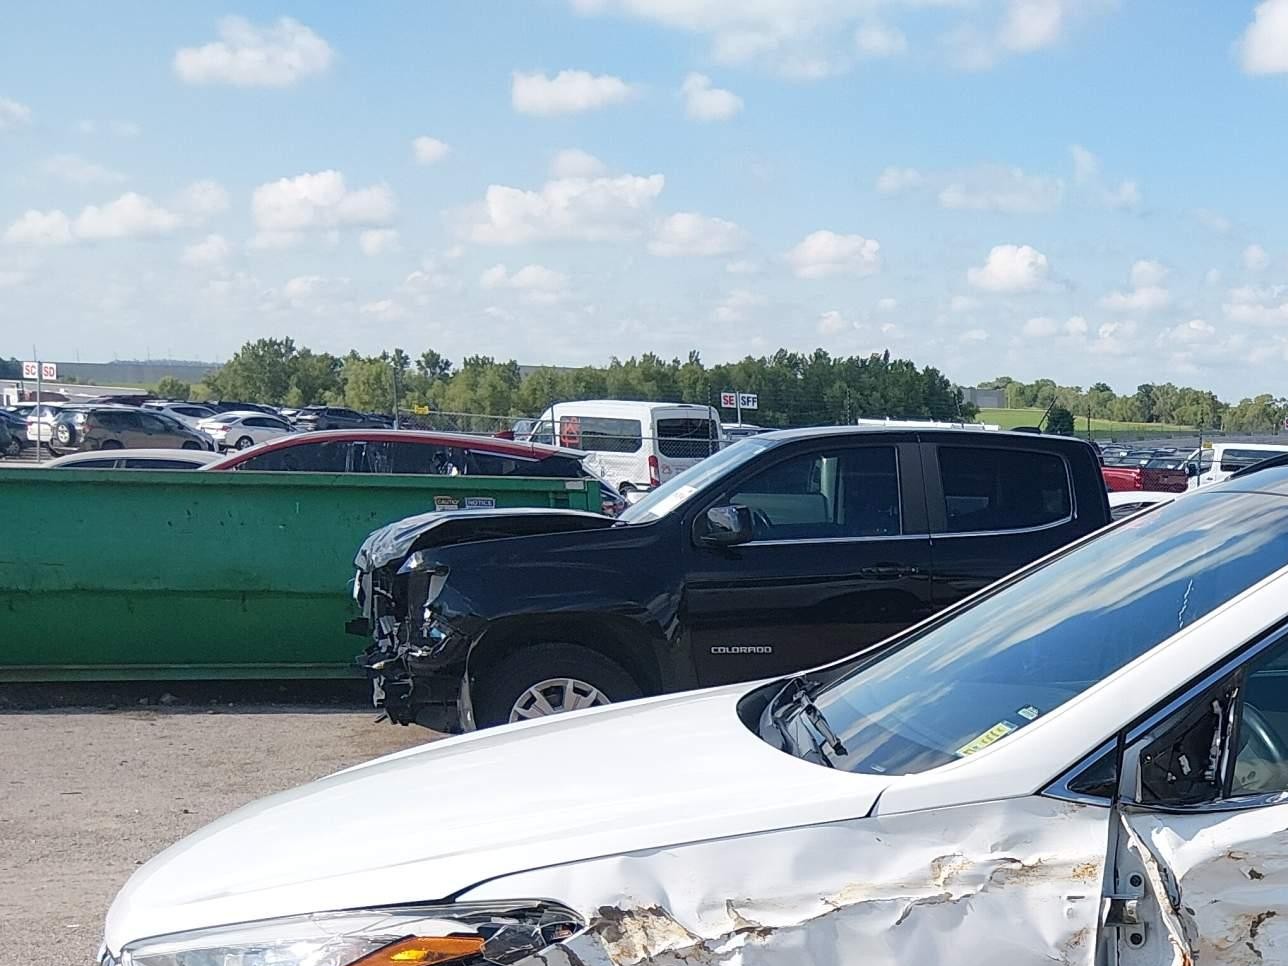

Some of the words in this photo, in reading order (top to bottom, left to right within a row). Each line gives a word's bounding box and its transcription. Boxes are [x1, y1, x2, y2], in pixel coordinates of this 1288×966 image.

[25, 365, 36, 376] SC
[43, 366, 55, 377] SD
[723, 395, 735, 406] SE
[741, 396, 757, 406] SFF
[711, 646, 772, 654] COLORADO
